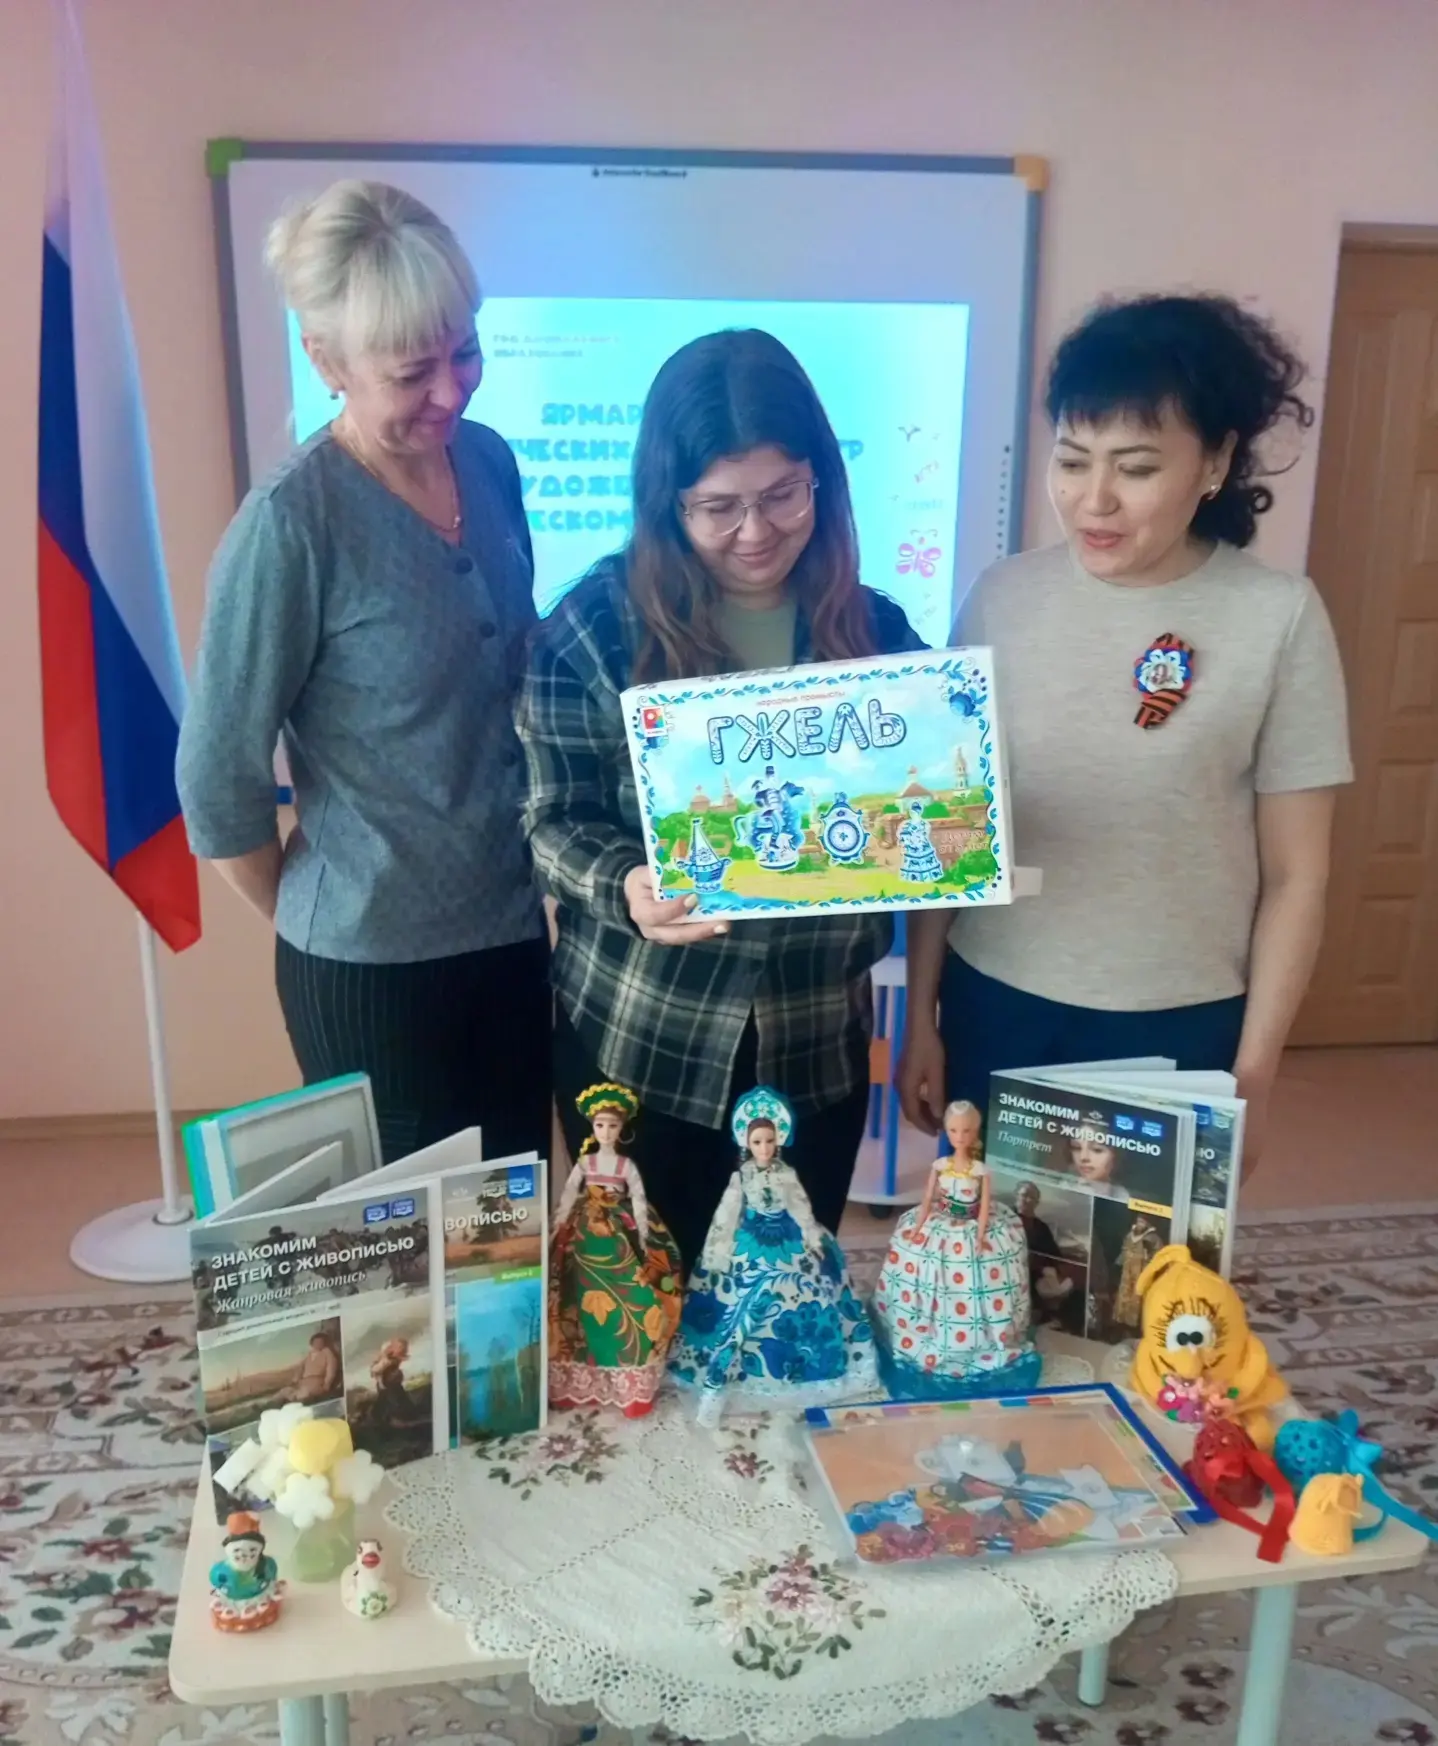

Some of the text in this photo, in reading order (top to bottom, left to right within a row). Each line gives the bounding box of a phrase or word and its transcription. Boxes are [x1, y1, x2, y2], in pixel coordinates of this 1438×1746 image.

[541, 403, 643, 425] ЯРМАР
[507, 439, 631, 462] ЧЕСКИХ
[520, 474, 633, 497] УДОЖЕ
[524, 510, 633, 531] ЕСКОМ
[706, 698, 907, 765] ГЖЕЛЬ
[999, 1093, 1080, 1121] ЗНАКОМИМ
[997, 1131, 1052, 1154] Портрет
[998, 1110, 1043, 1130] ДЕТЕЙ
[1046, 1121, 1057, 1134] С
[1060, 1124, 1162, 1157] ЖИВОПИСЬЮ
[445, 1206, 528, 1231] ВОПИСЬЮ
[211, 1236, 317, 1269] ЗНАКОМИМ
[213, 1236, 415, 1292] ДЕТЕЙ С ЖИВОПИСЬЮ
[215, 1270, 367, 1315] Жанровая живопись
